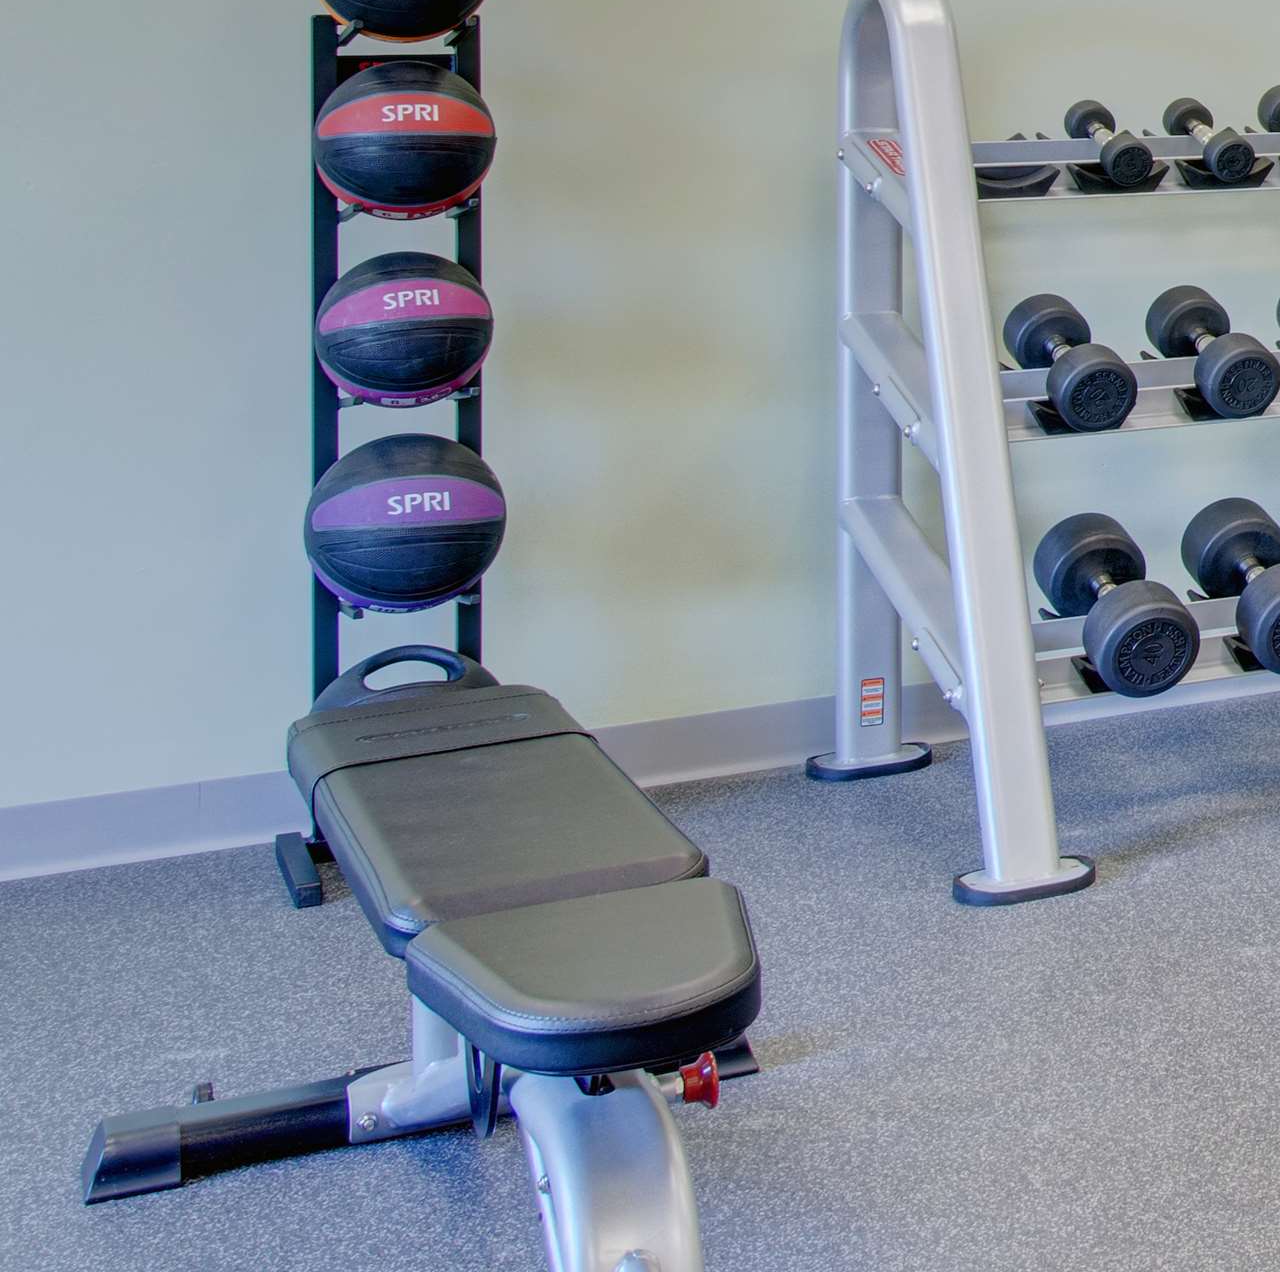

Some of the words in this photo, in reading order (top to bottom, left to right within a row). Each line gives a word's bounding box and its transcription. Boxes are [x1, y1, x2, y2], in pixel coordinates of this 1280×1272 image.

[382, 103, 439, 122] SPRI
[383, 289, 440, 310] SPRI
[387, 491, 451, 515] SPRI
